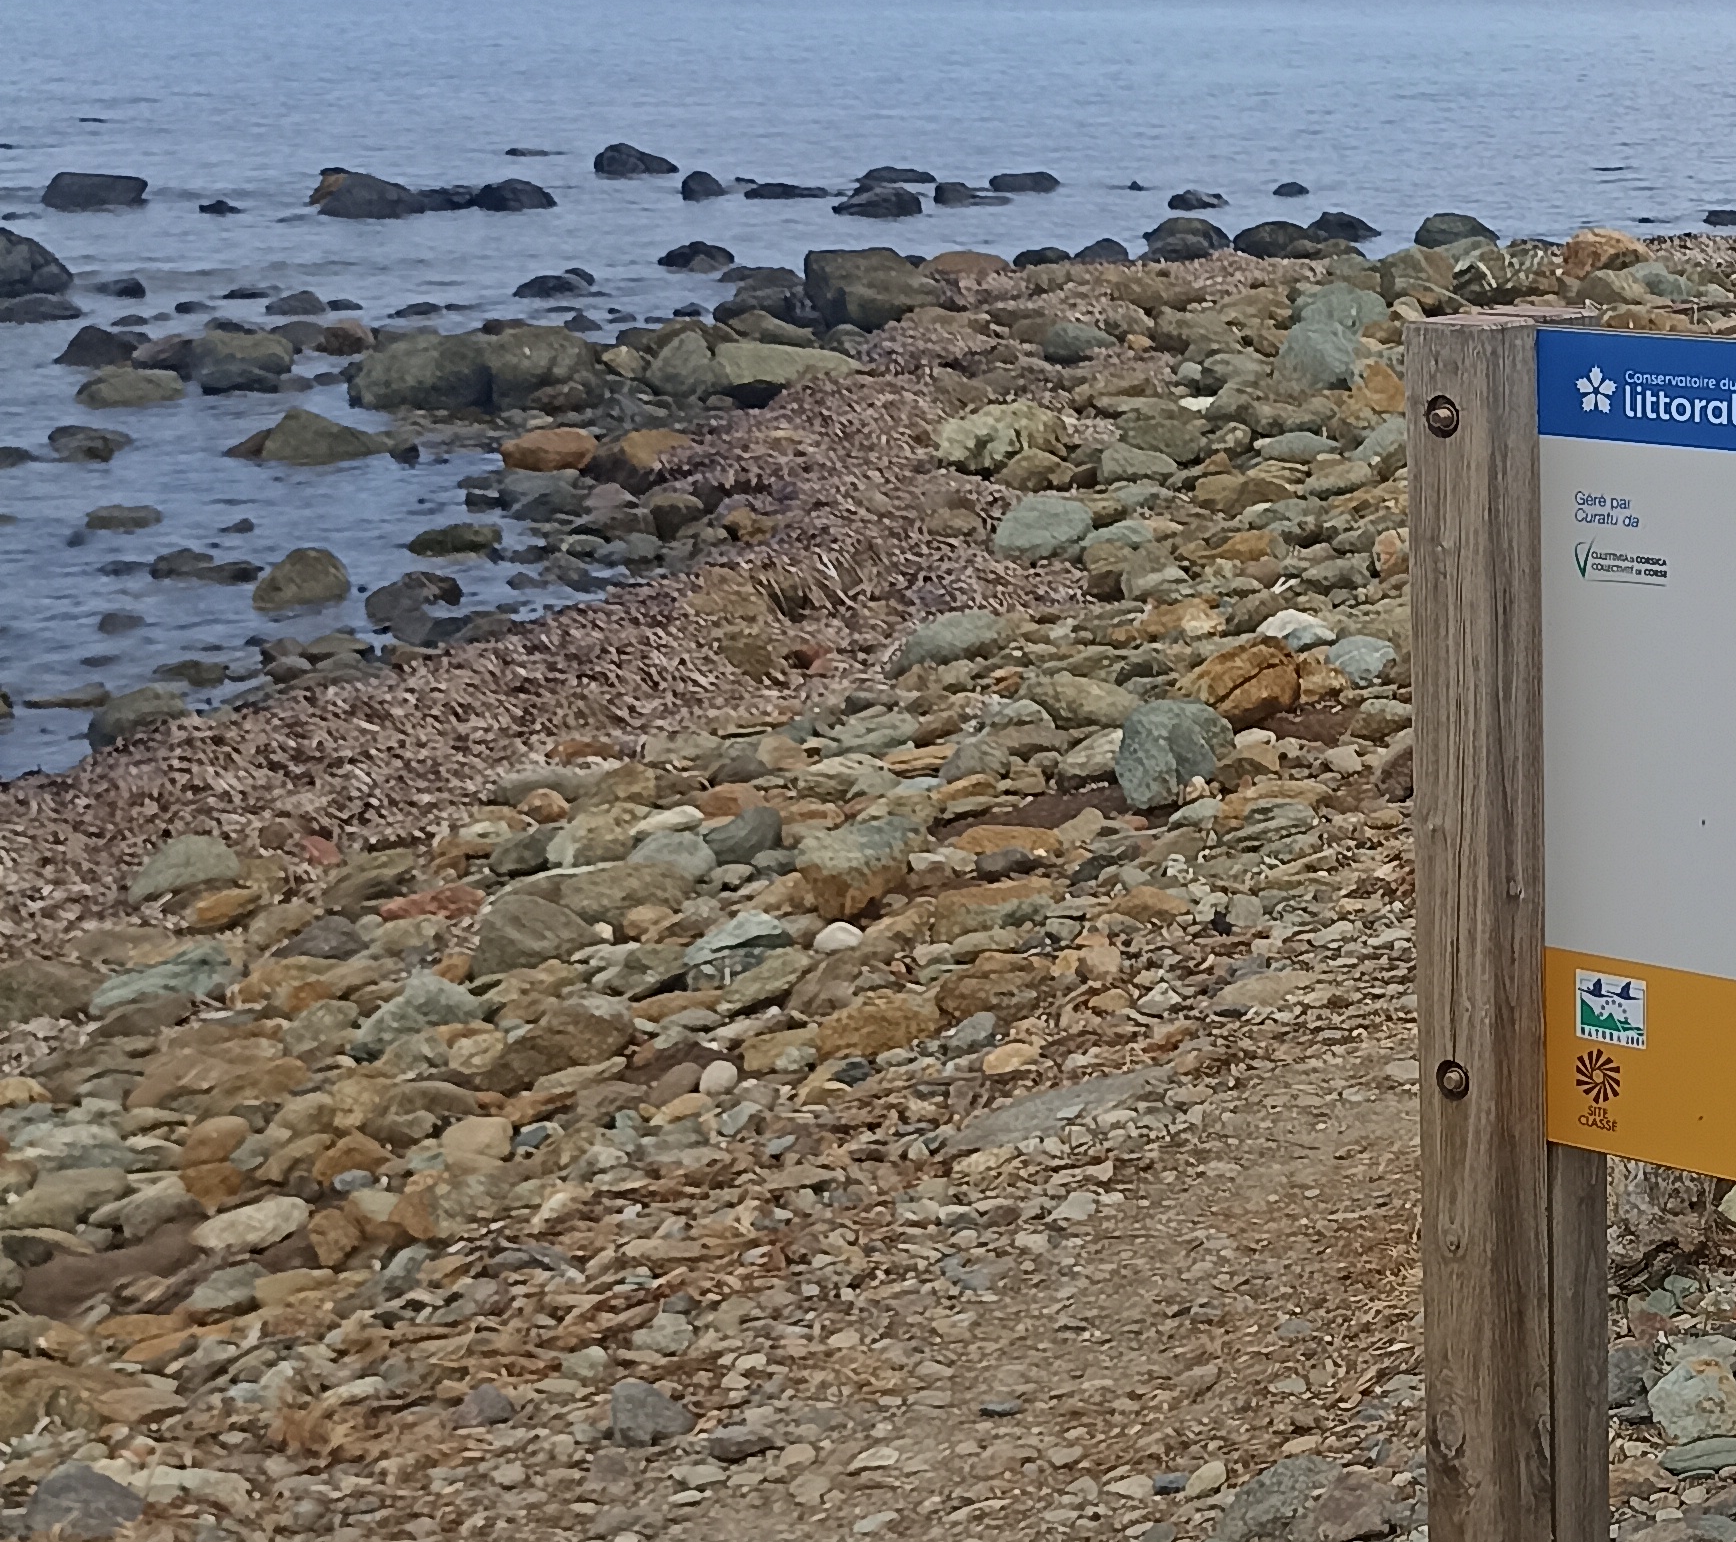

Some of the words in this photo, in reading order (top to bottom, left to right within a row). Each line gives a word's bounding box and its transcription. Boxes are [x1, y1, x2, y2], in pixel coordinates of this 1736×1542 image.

[1625, 370, 1717, 389] Conservatoire
[1575, 490, 1607, 507] Géré
[1610, 497, 1631, 510] par
[1575, 507, 1618, 525] Curatu
[1622, 514, 1639, 527] da
[1587, 1104, 1609, 1119] SITE
